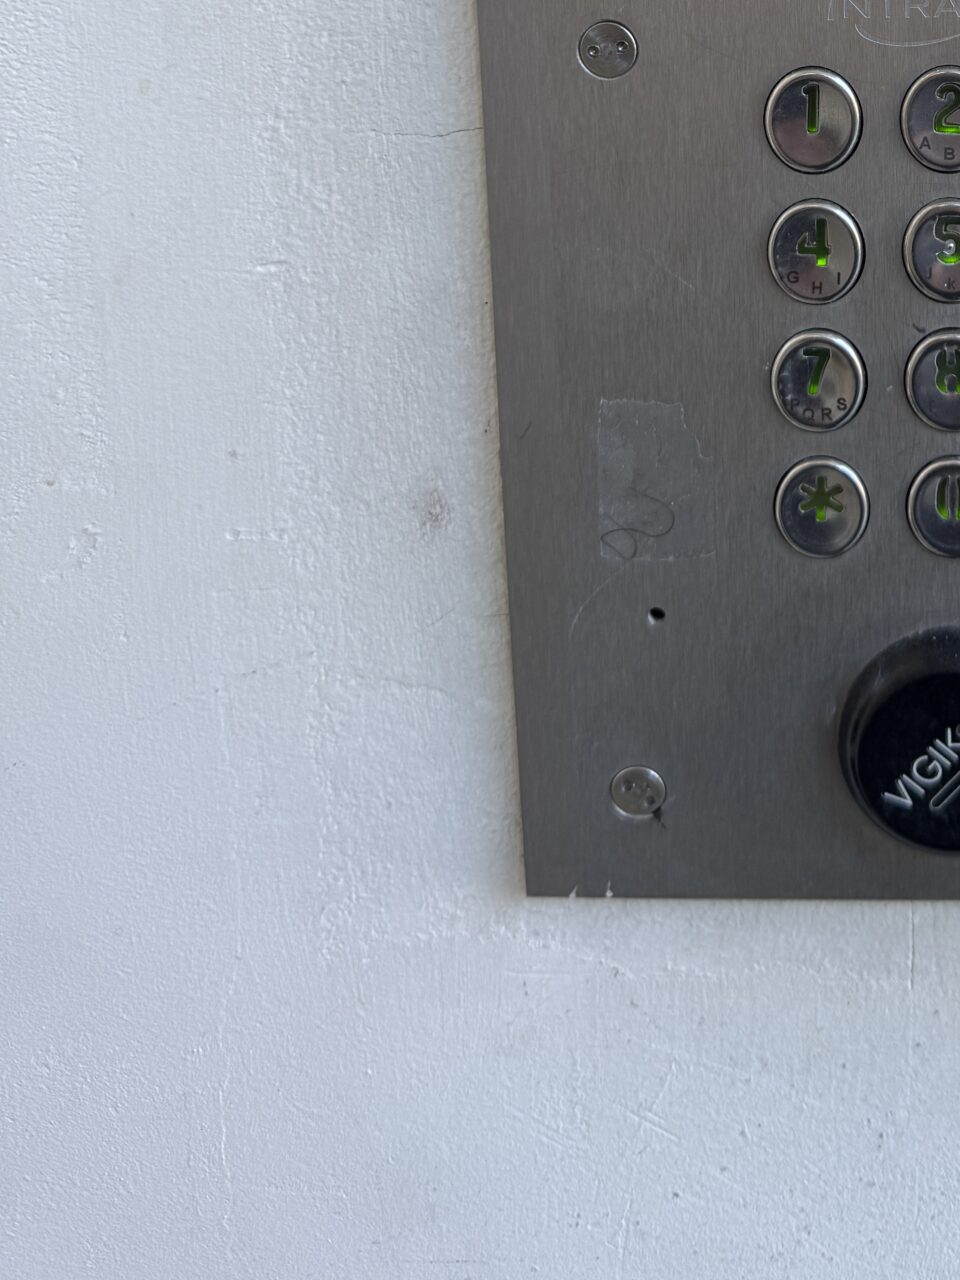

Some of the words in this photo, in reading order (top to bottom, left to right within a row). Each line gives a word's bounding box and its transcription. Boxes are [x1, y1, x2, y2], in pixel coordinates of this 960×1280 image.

[801, 82, 821, 135] 1
[796, 218, 831, 267] 4
[803, 347, 831, 396] 7
